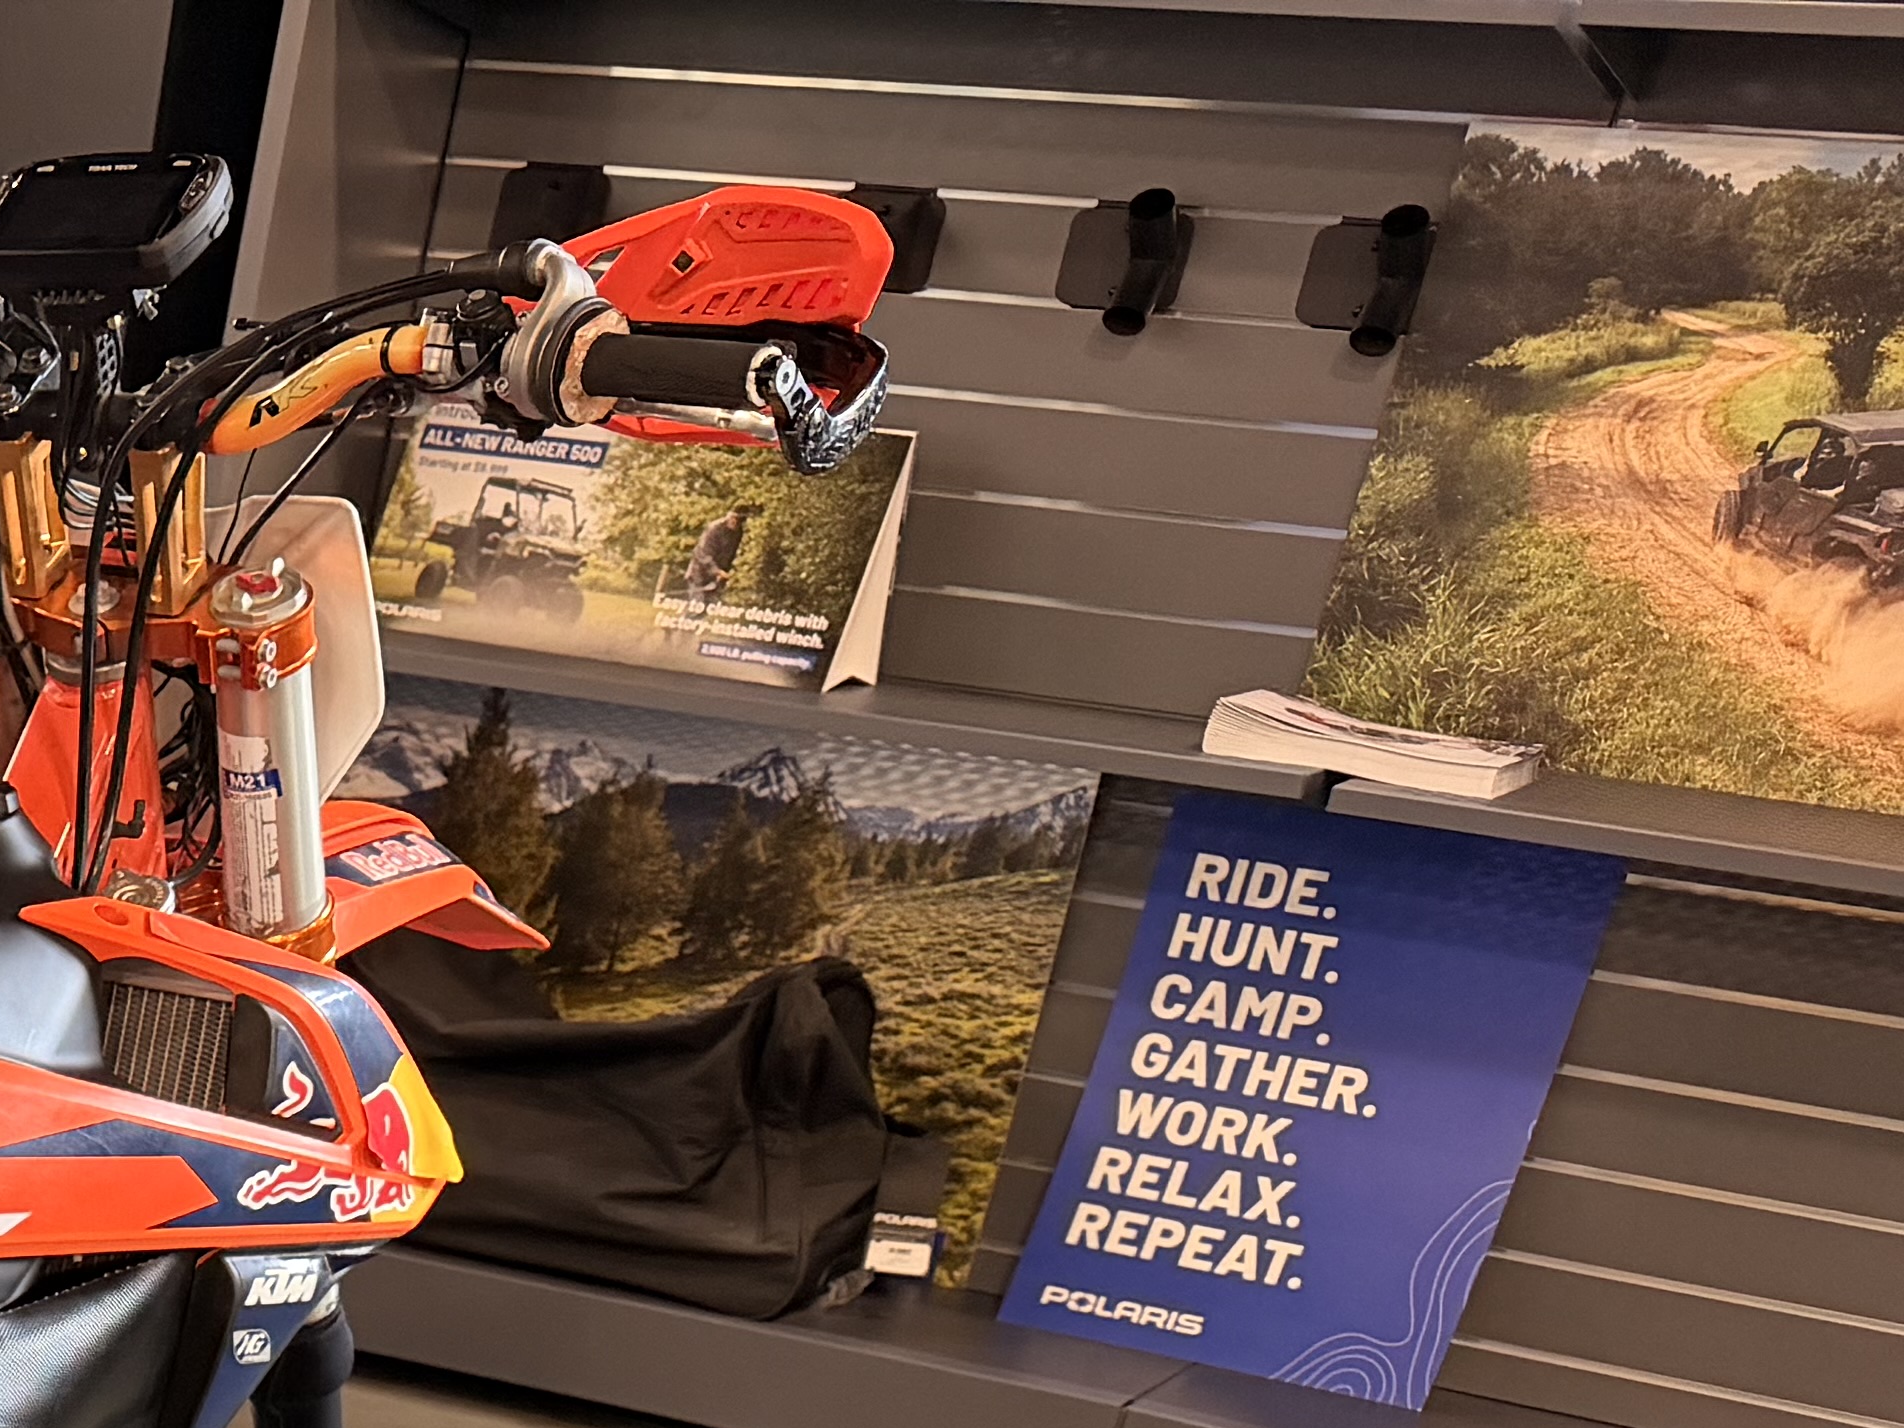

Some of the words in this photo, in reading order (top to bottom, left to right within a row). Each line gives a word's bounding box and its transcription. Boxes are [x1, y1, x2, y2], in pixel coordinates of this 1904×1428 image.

[423, 427, 502, 452] ALL-NEW
[501, 436, 569, 460] RANGER
[652, 592, 689, 614] Easy
[689, 599, 705, 614] to
[706, 601, 745, 619] clear
[745, 606, 792, 626] debris
[794, 613, 830, 632] with
[654, 611, 776, 642] factory-installed
[776, 630, 825, 649] winch.
[1185, 853, 1338, 920] RIDE.
[1167, 913, 1340, 984] HUNT.
[1150, 973, 1332, 1047] CAMP.
[1130, 1032, 1378, 1118] GATHER.
[1116, 1089, 1298, 1167] WORK.
[1085, 1147, 1302, 1230] RELAX.
[1064, 1202, 1305, 1291] REPEAT.
[244, 1267, 319, 1307] KTM
[1039, 1284, 1205, 1337] POLARIS
